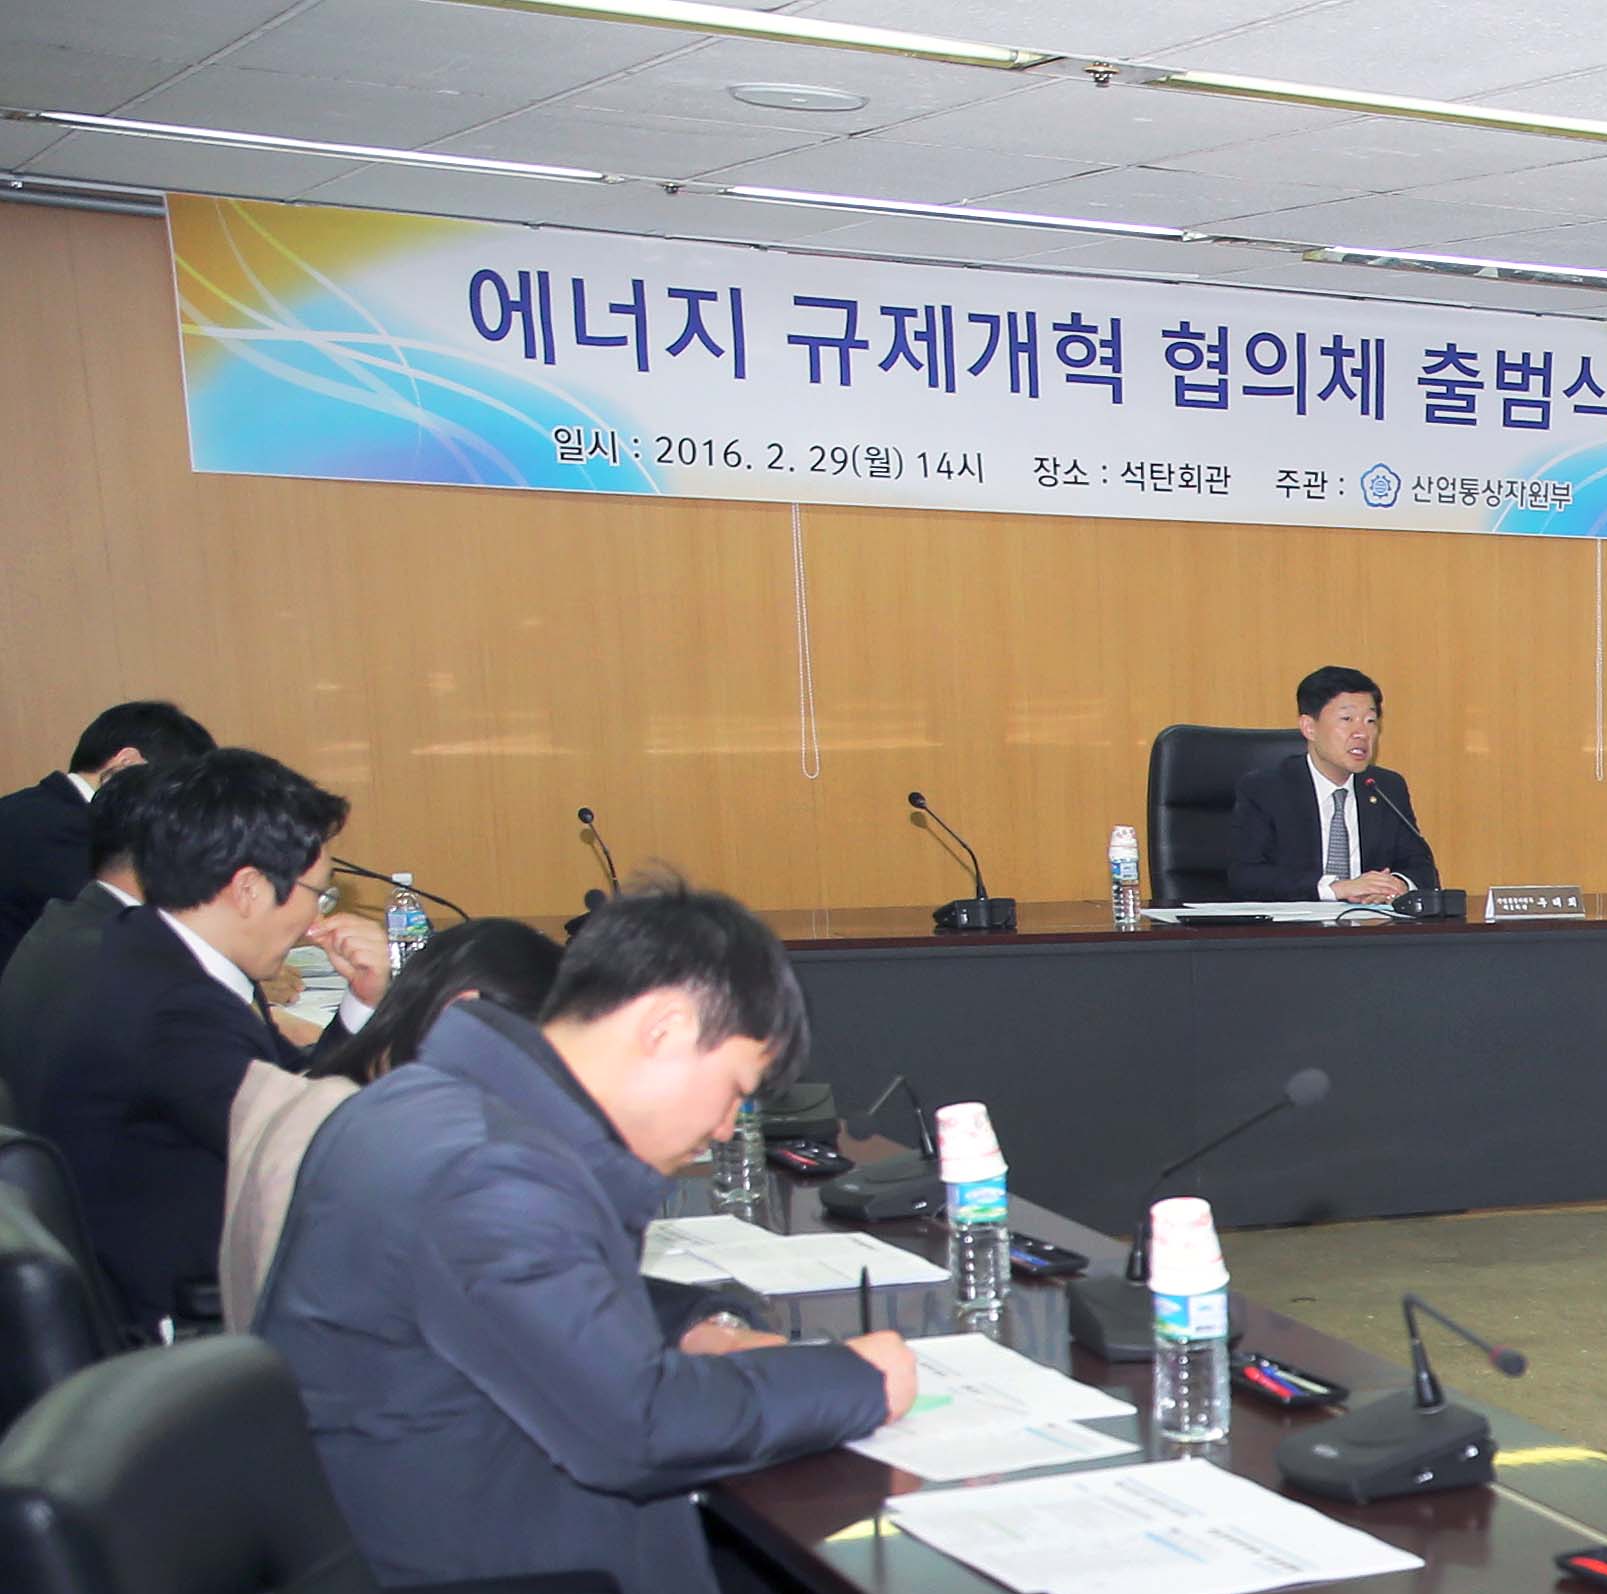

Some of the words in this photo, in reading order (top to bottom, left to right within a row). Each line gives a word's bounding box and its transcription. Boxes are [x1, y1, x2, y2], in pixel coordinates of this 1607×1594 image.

[468, 267, 747, 381] 에너지
[786, 294, 1125, 406] 규제개혁
[1160, 318, 1386, 422] 협의체
[553, 427, 619, 464] 일시
[654, 435, 754, 471] 2016.
[766, 441, 797, 473] 2.
[808, 443, 905, 481] 29(월)
[917, 451, 985, 485] 14시
[1032, 456, 1091, 489] 장소
[1119, 460, 1232, 496] 석탄회관
[1275, 468, 1329, 501] 주관
[1411, 474, 1573, 511] 산업통상자원부
